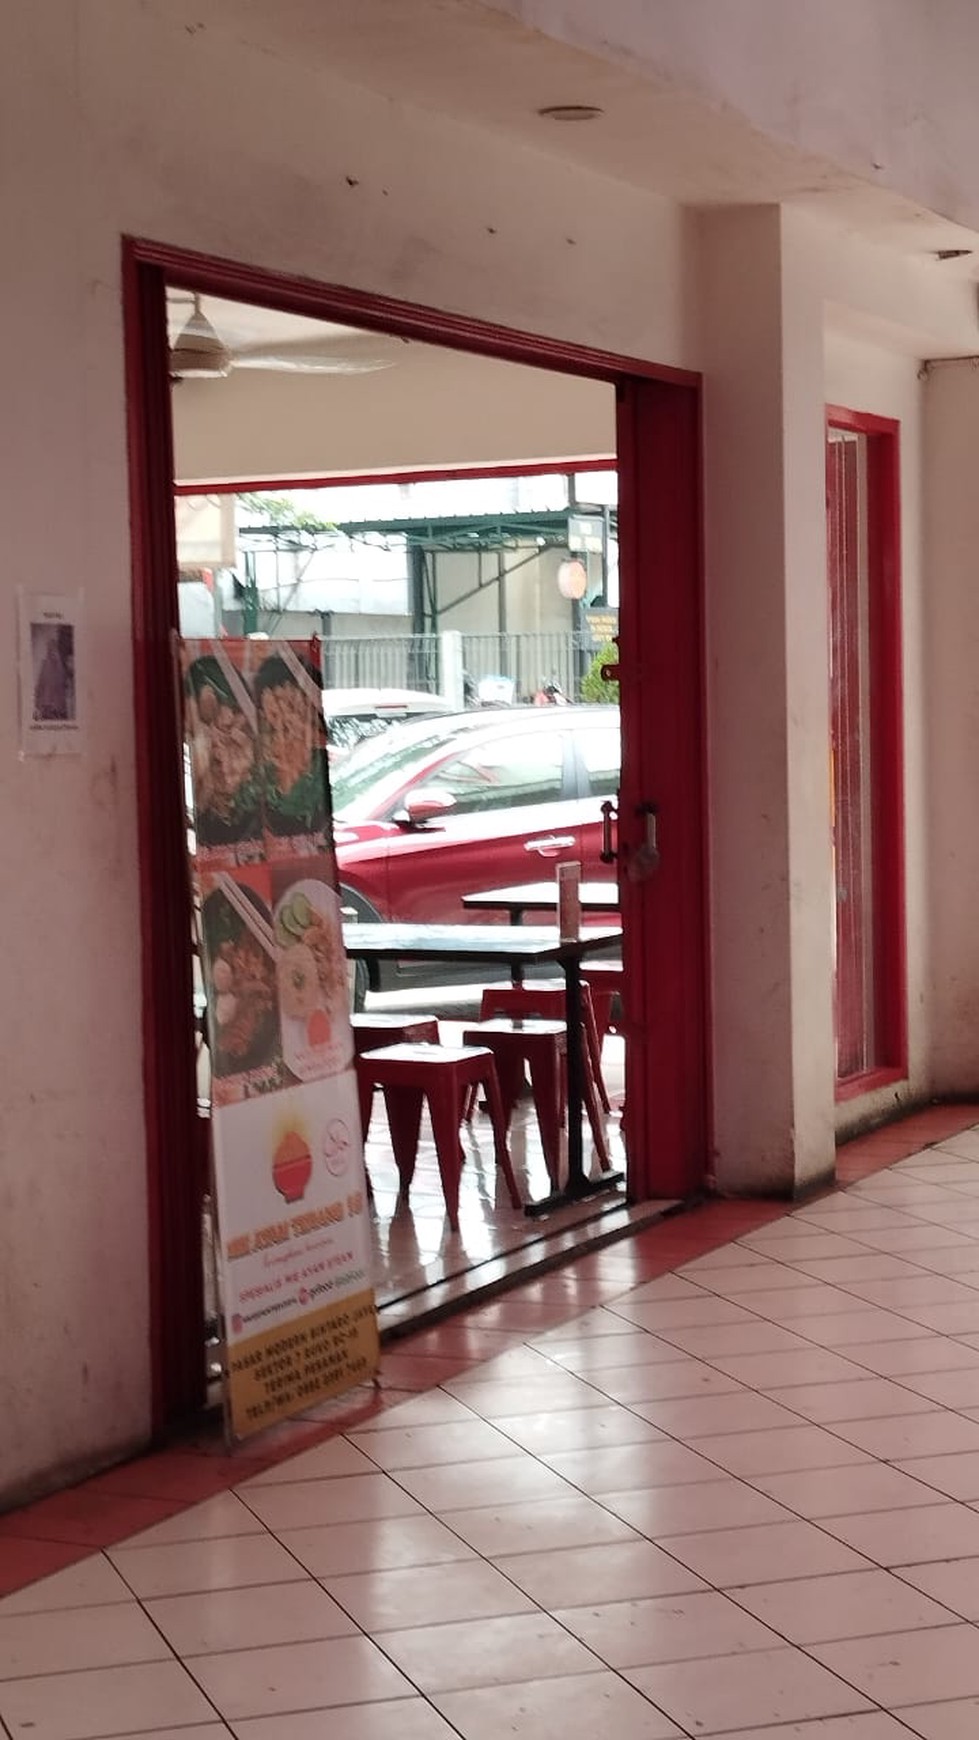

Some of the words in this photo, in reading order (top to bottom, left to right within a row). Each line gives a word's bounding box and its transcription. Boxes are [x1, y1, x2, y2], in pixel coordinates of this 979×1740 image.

[264, 1333, 307, 1357] MODERN
[309, 1313, 349, 1339] BINTARO
[255, 1355, 293, 1381] SEKTOR
[264, 1370, 302, 1393] TERIMA
[304, 1350, 349, 1375] PESANAN
